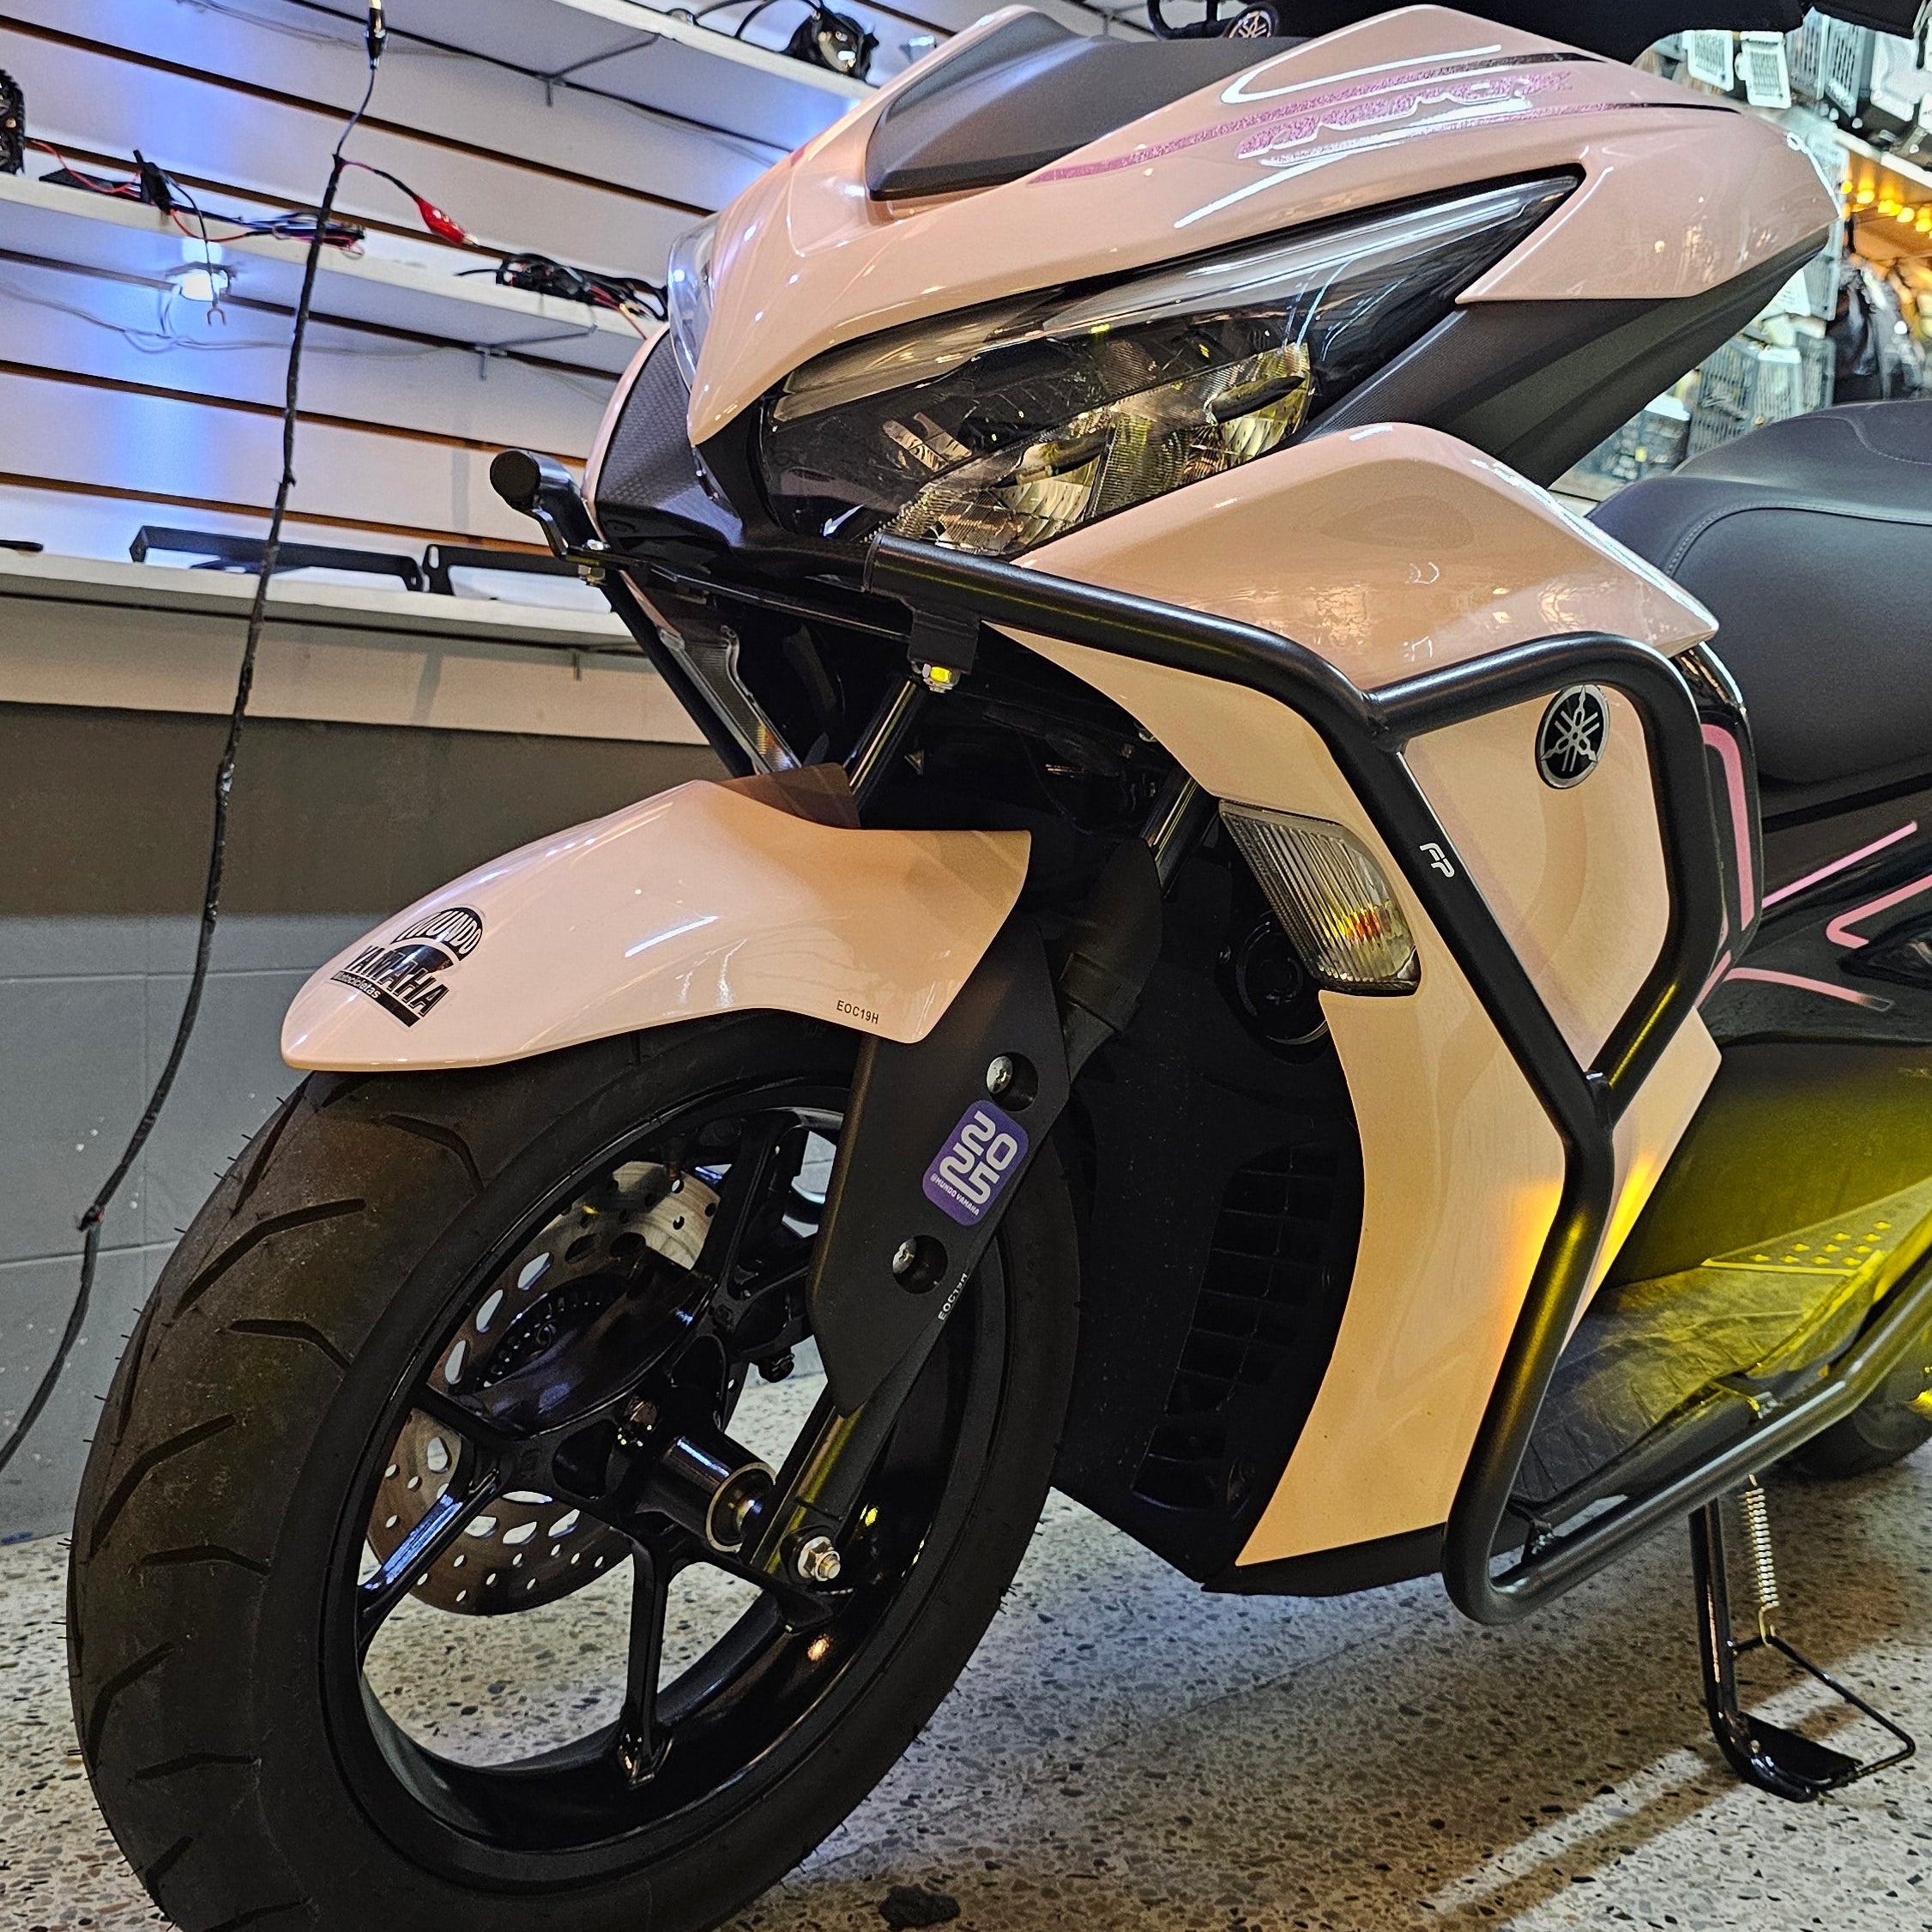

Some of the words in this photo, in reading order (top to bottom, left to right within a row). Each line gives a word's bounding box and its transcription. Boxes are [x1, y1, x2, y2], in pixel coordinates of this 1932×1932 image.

[395, 910, 481, 955] MUNDO
[343, 945, 450, 1017] YAMAHA
[836, 999, 879, 1024] EOC19H
[956, 1193, 980, 1216] YAMAHA
